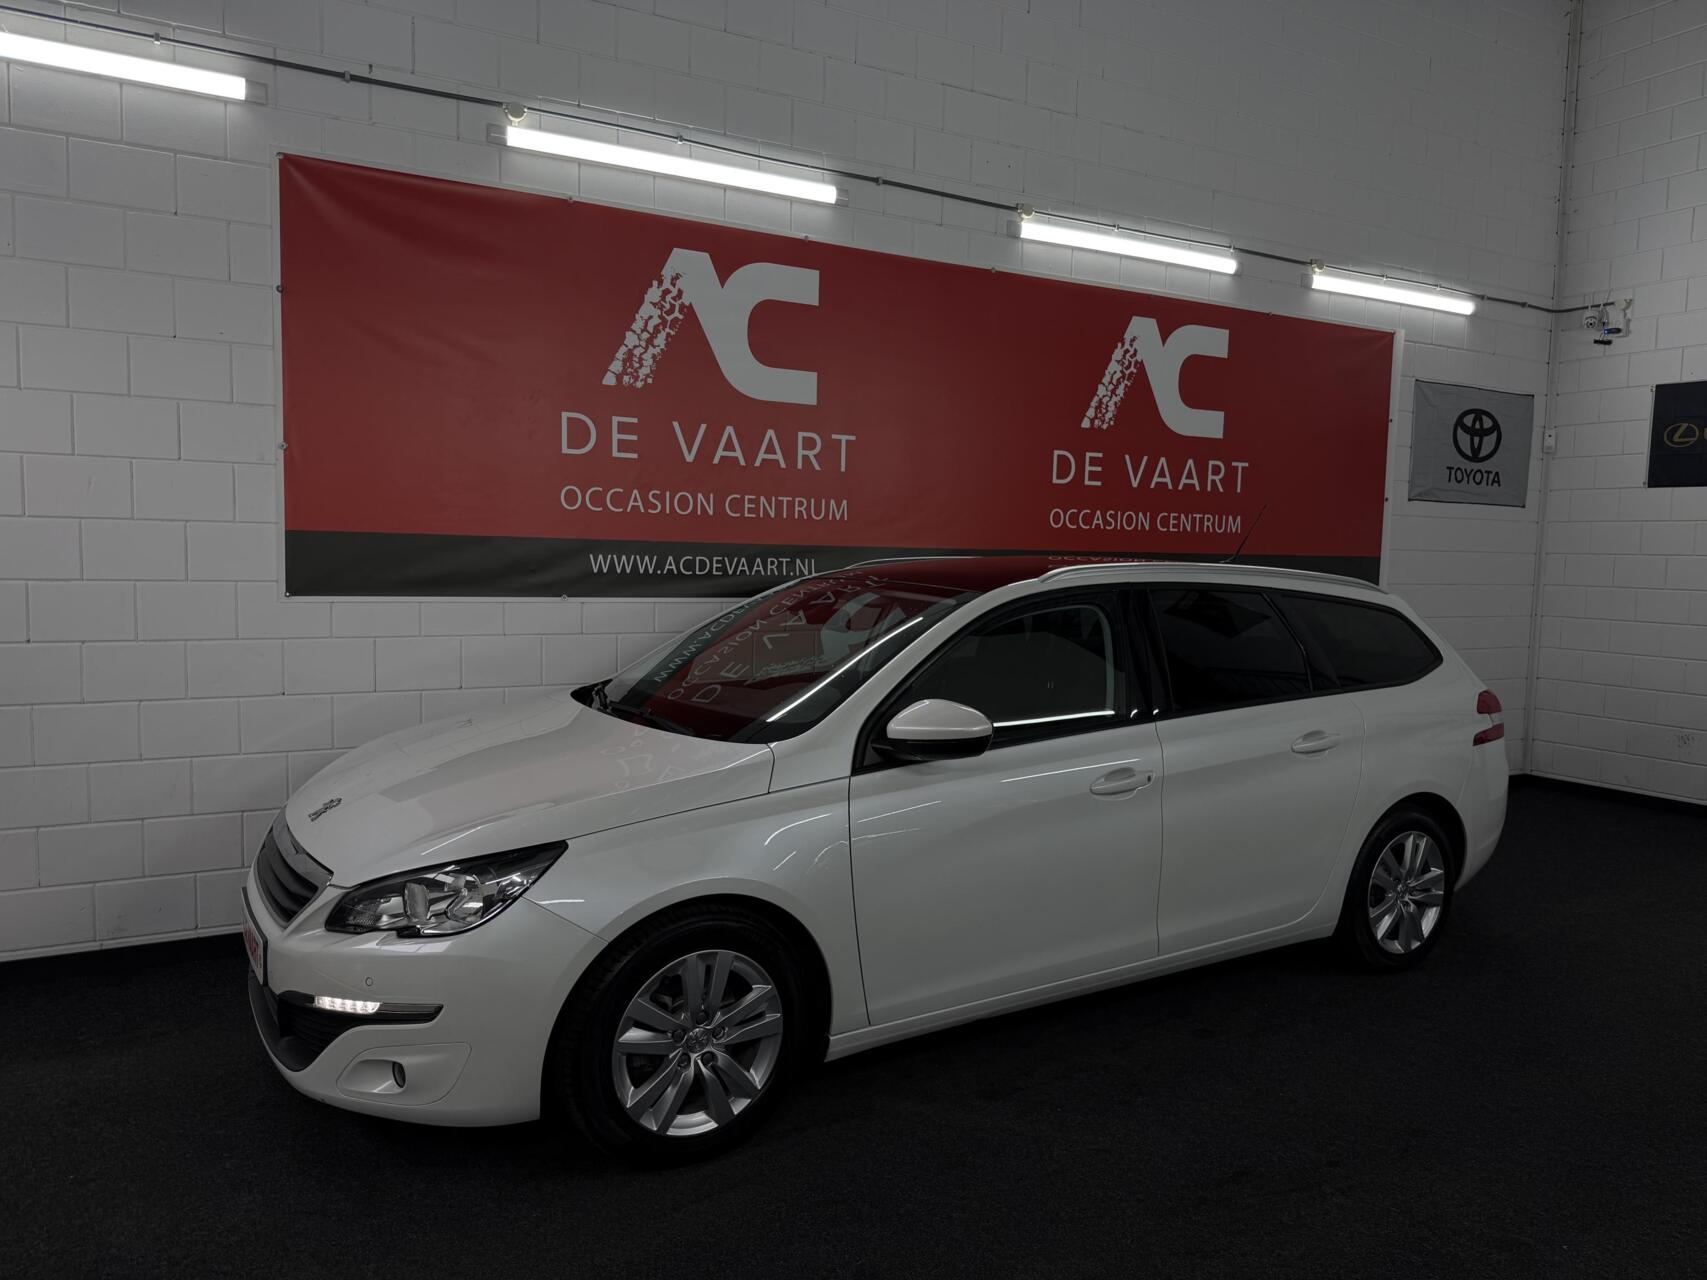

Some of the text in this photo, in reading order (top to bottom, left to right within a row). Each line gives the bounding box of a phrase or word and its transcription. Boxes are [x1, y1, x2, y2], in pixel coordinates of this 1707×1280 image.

[602, 247, 820, 406] AC
[1081, 315, 1230, 439] AC
[560, 411, 856, 472] DE VAART
[1052, 449, 1249, 494] DE VAART
[1446, 466, 1501, 487] TOYOTA
[560, 485, 848, 521] OCCASION CENTRUM
[1050, 508, 1241, 534] OCCASION CENTRUM
[589, 554, 817, 576] WWW.ACDEVAART.NL
